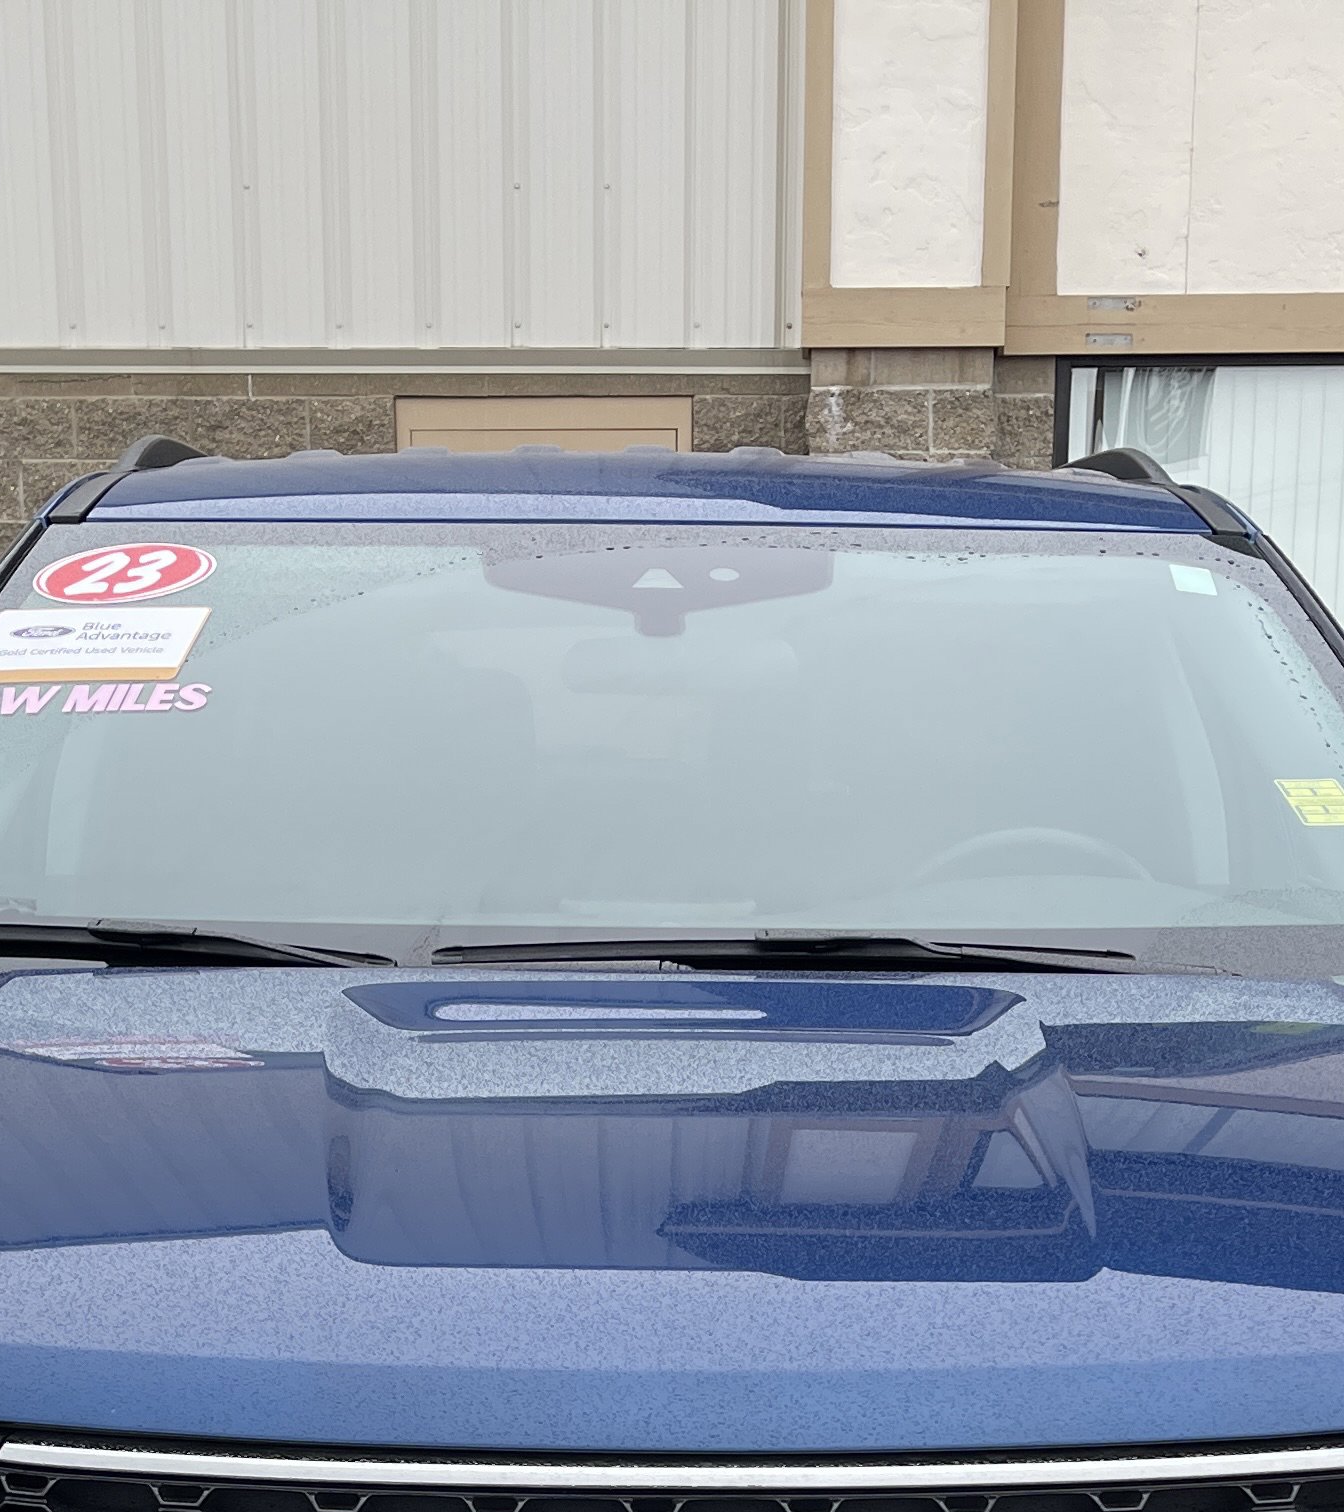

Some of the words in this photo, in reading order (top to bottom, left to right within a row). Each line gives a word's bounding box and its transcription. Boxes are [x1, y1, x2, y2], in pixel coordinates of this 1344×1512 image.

[63, 549, 178, 596] 23
[82, 622, 122, 630] Blue
[76, 632, 172, 641] Advantage
[30, 646, 82, 655] Certified
[85, 646, 116, 654] Used
[120, 646, 164, 654] Vehicle
[62, 683, 213, 714] MILES
